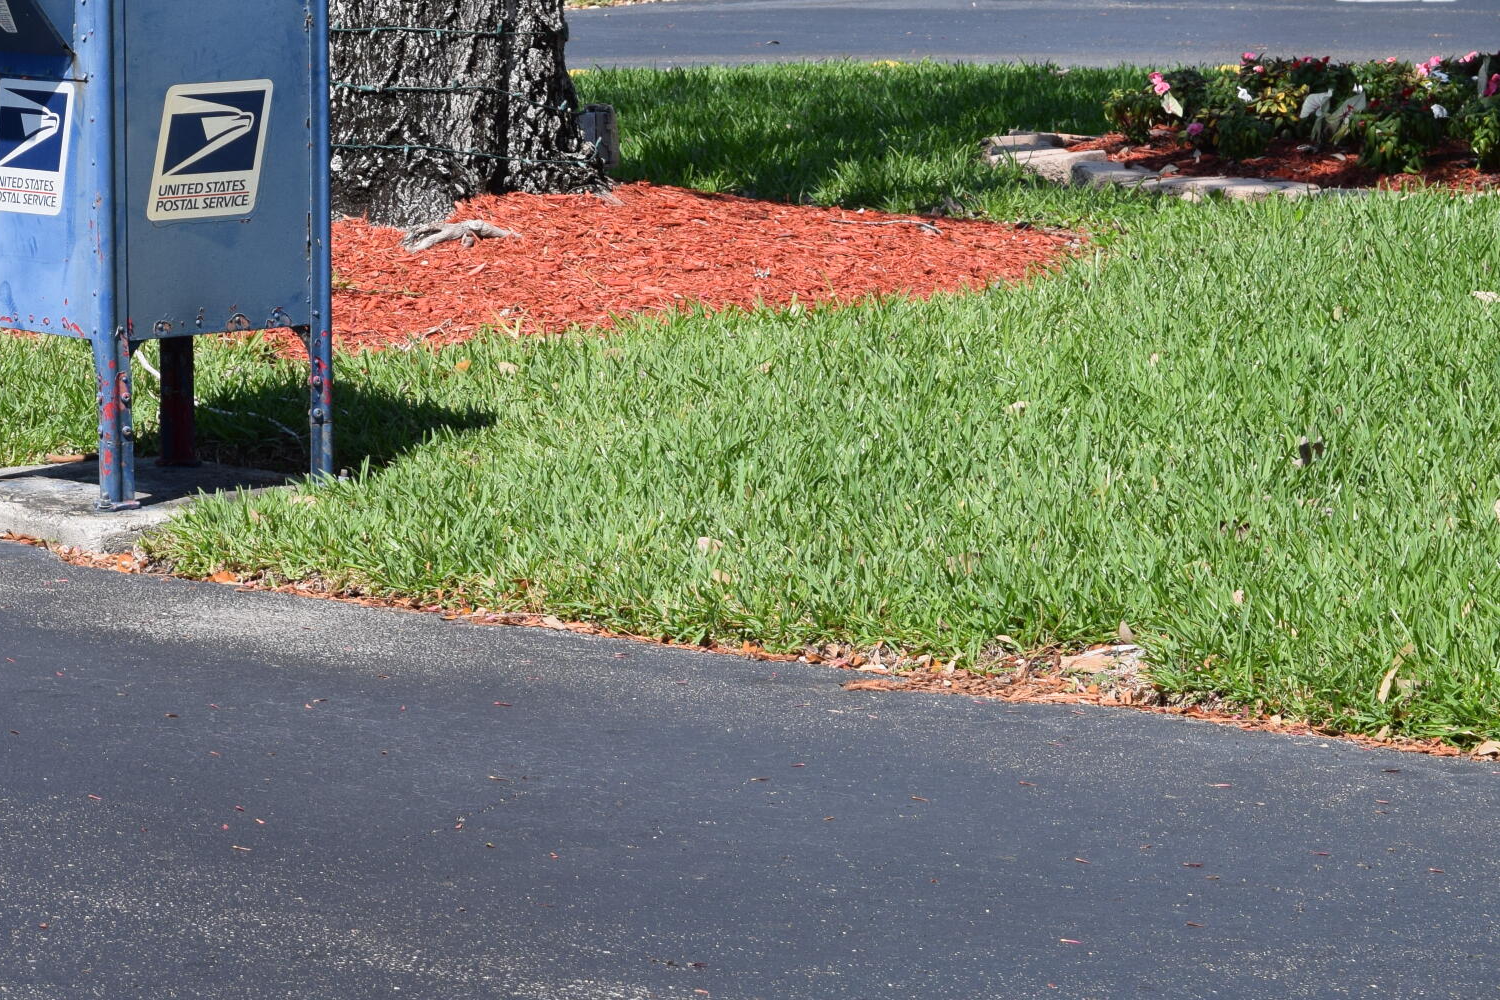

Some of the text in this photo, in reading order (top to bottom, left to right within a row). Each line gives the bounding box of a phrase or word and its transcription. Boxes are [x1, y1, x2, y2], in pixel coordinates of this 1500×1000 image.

[25, 178, 54, 192] STATES
[158, 179, 246, 196] UNITED STATES
[23, 193, 57, 208] SERVICE
[155, 194, 249, 212] POSTAL SERVICE
